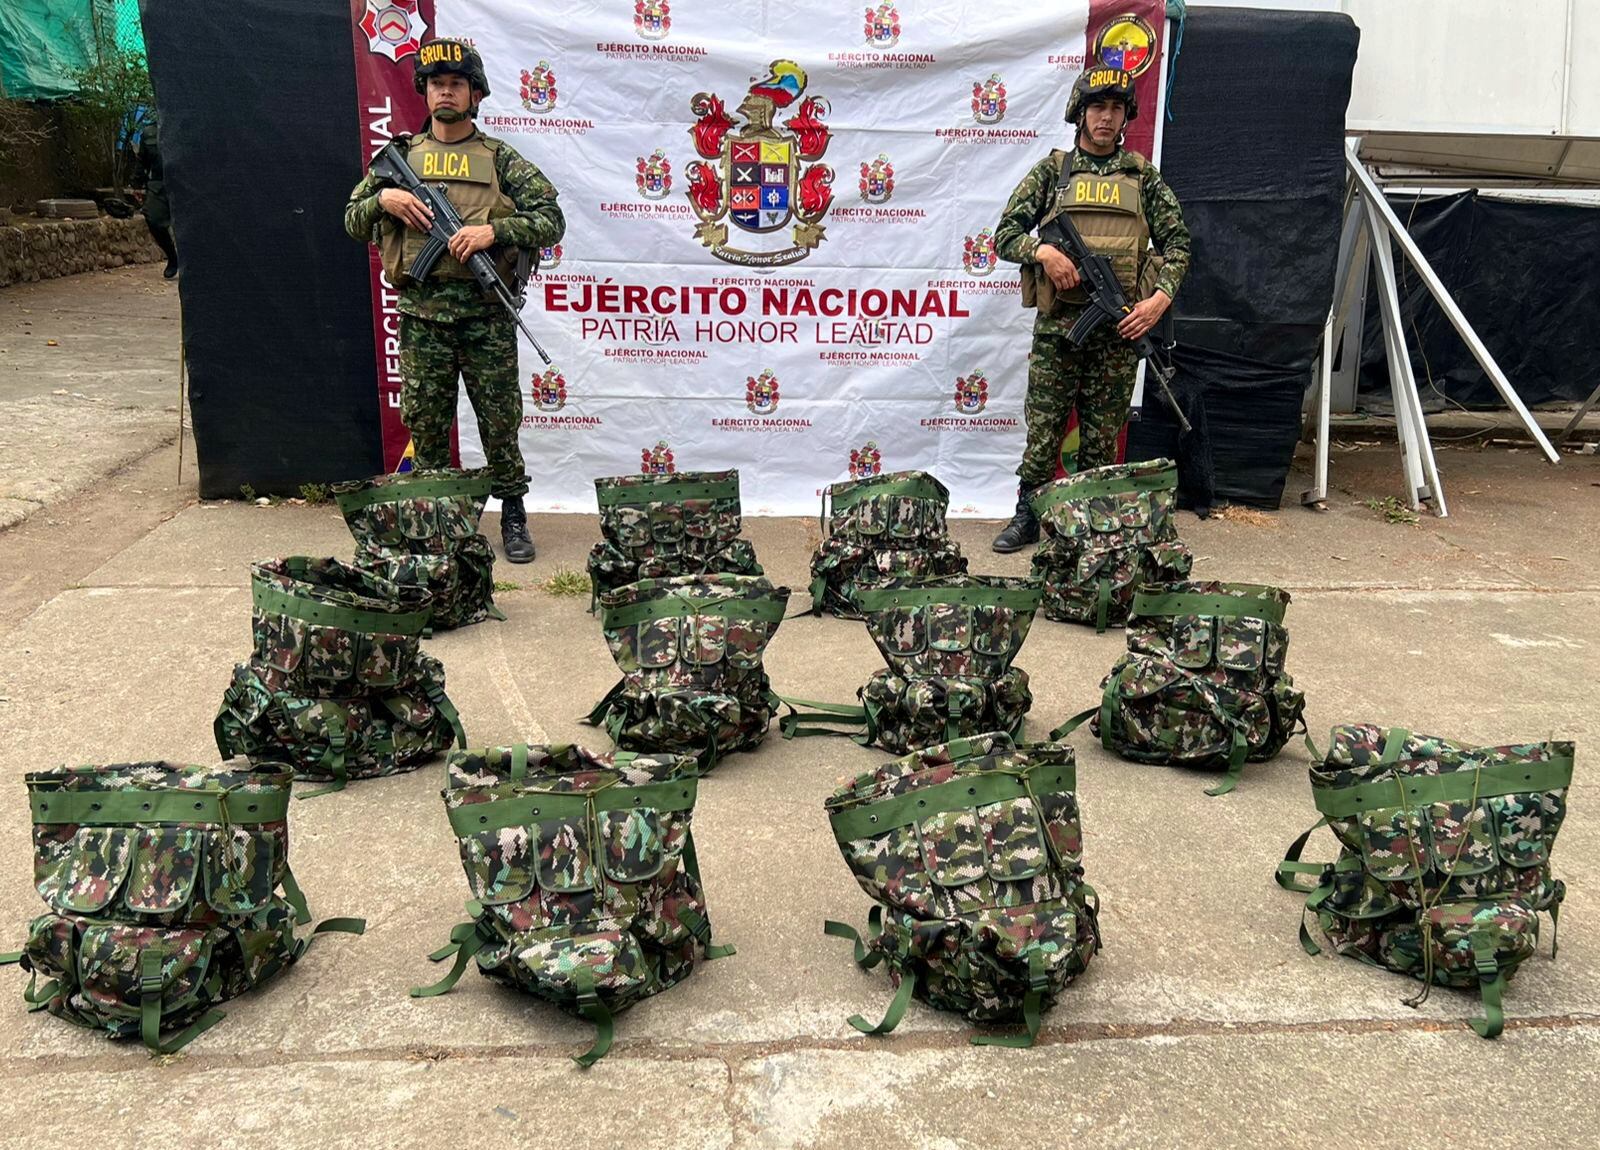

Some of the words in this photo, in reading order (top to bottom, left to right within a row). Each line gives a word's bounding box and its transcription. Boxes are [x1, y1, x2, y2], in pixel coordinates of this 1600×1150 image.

[596, 42, 650, 52] EJÉRCITO
[652, 45, 708, 55] NACIONAL
[420, 44, 451, 65] GRULI
[828, 52, 880, 61] EJÉRCITO
[883, 53, 936, 62] NACIONAL
[1048, 55, 1084, 64] EJÉRCI
[1090, 70, 1120, 88] GRULI
[484, 116, 536, 126] EJÉRCITO
[540, 119, 594, 128] NACIONAL
[554, 128, 586, 136] LEALTAD
[935, 128, 984, 137] EJÉRCITO
[988, 129, 1038, 138] NACIONAL
[423, 152, 470, 177] BLICA
[1076, 181, 1120, 205] BLICA
[600, 202, 652, 212] EJÉRCITO
[638, 212, 664, 220] HONOR
[875, 209, 926, 217] NACIONAL
[546, 274, 598, 283] NACIONAL
[712, 277, 760, 286] EJÉRCITO
[764, 279, 816, 287] NACIONAL
[928, 280, 976, 288] EJÉRCITO
[544, 278, 746, 315] EJÉRCITO
[762, 288, 970, 317] NACIONAL
[582, 318, 680, 342] PATRIA
[696, 320, 798, 344] HONOR
[816, 322, 934, 344] LEALTAD
[604, 348, 654, 357] EJÉRCITO
[657, 350, 708, 358] NACIONAL
[820, 351, 867, 360] EJÉRCITO
[870, 352, 920, 360] NACIONAL
[551, 416, 602, 424] NACIONAL
[712, 418, 760, 426] EJÉRCITO
[920, 418, 966, 426] EJÉRCITO
[970, 418, 1018, 426] NACIONAL
